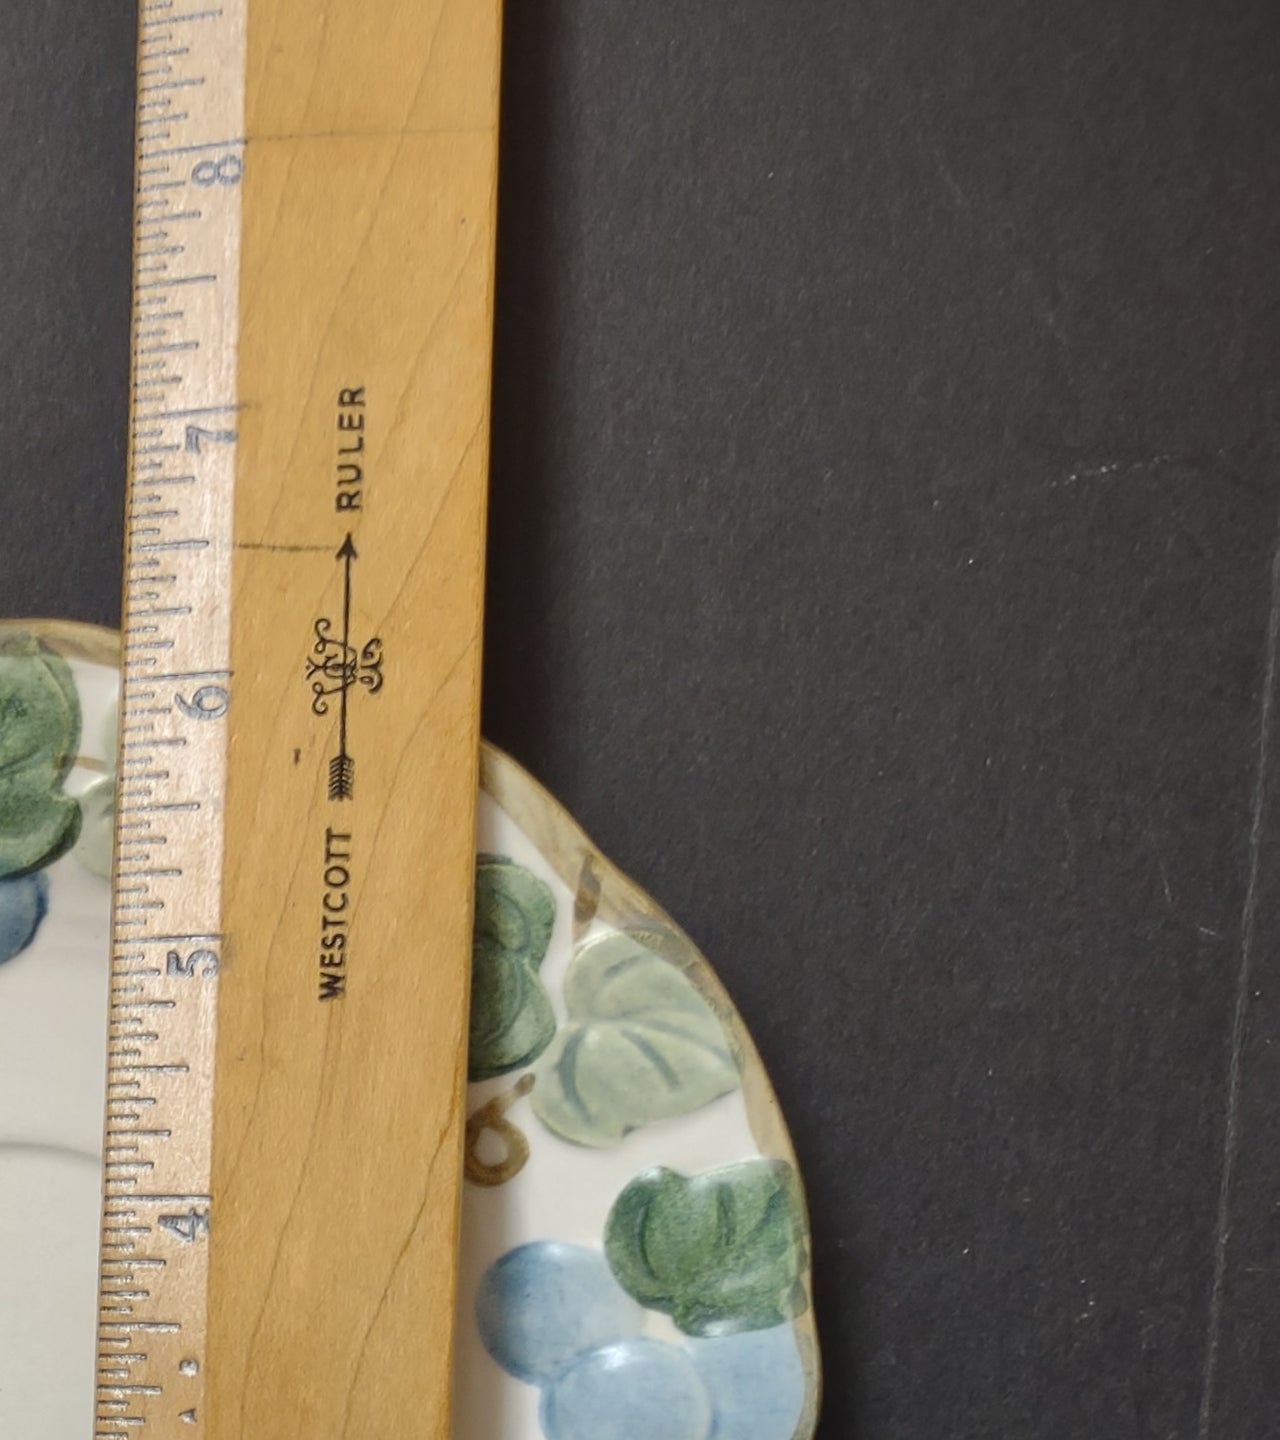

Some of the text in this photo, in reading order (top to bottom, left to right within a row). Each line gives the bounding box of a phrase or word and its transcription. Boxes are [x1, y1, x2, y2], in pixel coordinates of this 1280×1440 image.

[192, 154, 243, 187] 8
[185, 426, 238, 454] 7
[174, 686, 228, 721] 6
[318, 386, 365, 1002] WESTCOTT RULER
[166, 949, 219, 978] 5
[158, 1208, 210, 1243] 4
